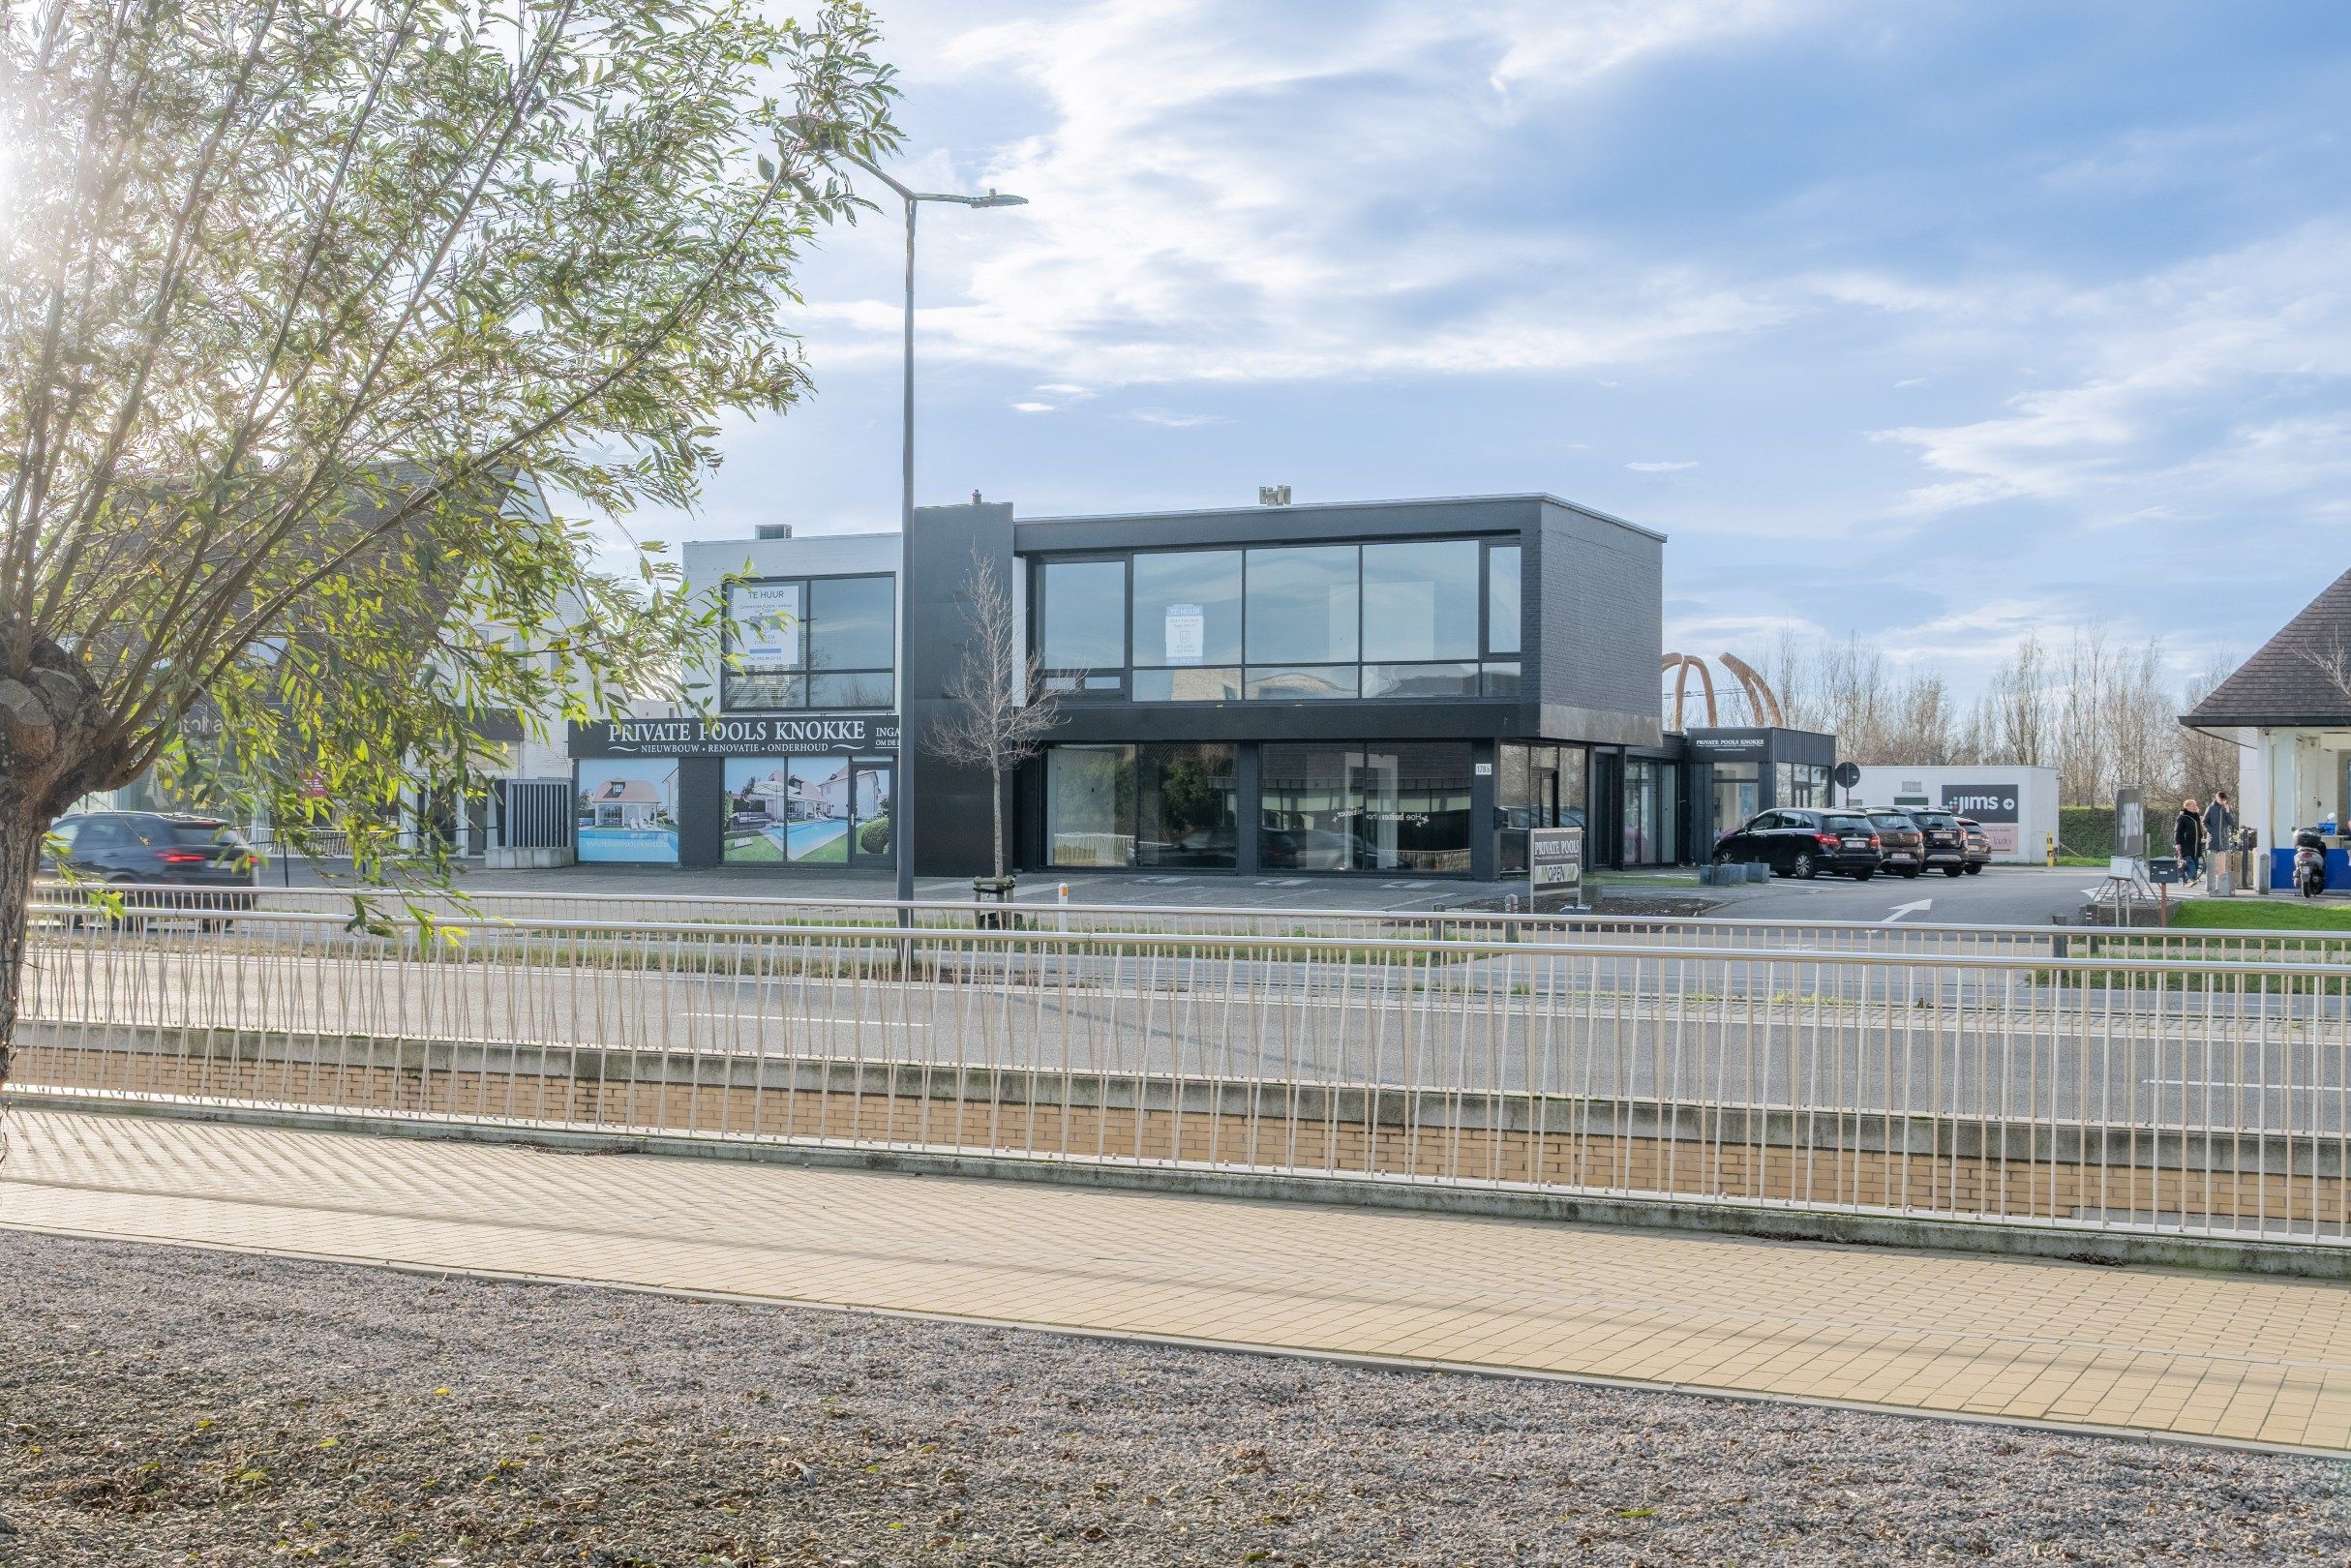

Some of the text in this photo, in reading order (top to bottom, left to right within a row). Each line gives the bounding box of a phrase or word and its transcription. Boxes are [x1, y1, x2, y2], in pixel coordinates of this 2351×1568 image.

[608, 723, 691, 742] PRIVATE
[774, 721, 866, 740] KNOKKE
[875, 727, 900, 737] INGA
[641, 744, 700, 753] NIEUWBOUW
[768, 743, 829, 752] ONDERHOUD
[1534, 839, 1580, 856] PRIVATE POOLS
[1548, 865, 1565, 882] OPEN
